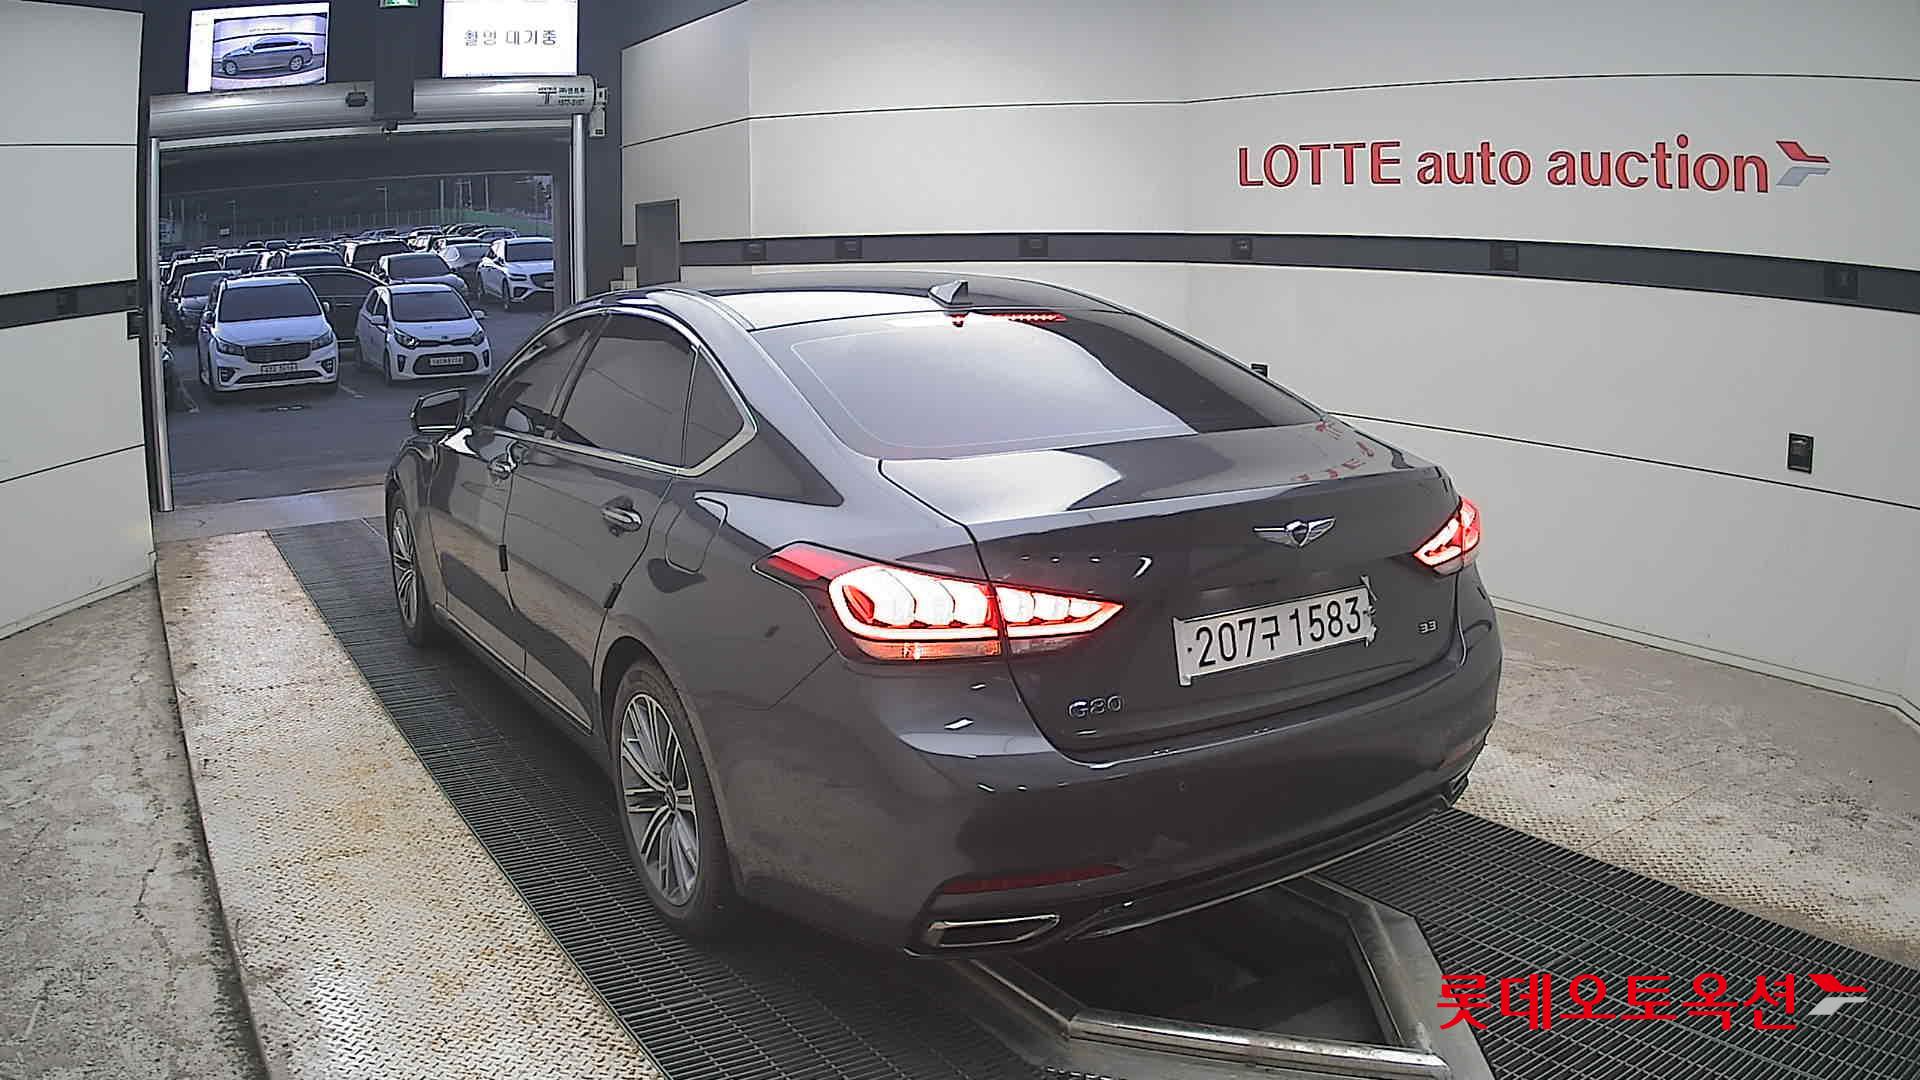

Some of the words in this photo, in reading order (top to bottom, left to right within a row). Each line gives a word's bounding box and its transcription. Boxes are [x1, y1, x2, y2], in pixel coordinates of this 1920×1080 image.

[505, 29, 557, 46] 대기중
[1238, 141, 1401, 188] LOTTE
[1416, 141, 1531, 186] auto
[1547, 133, 1769, 194] auction
[1068, 695, 1121, 717] G80
